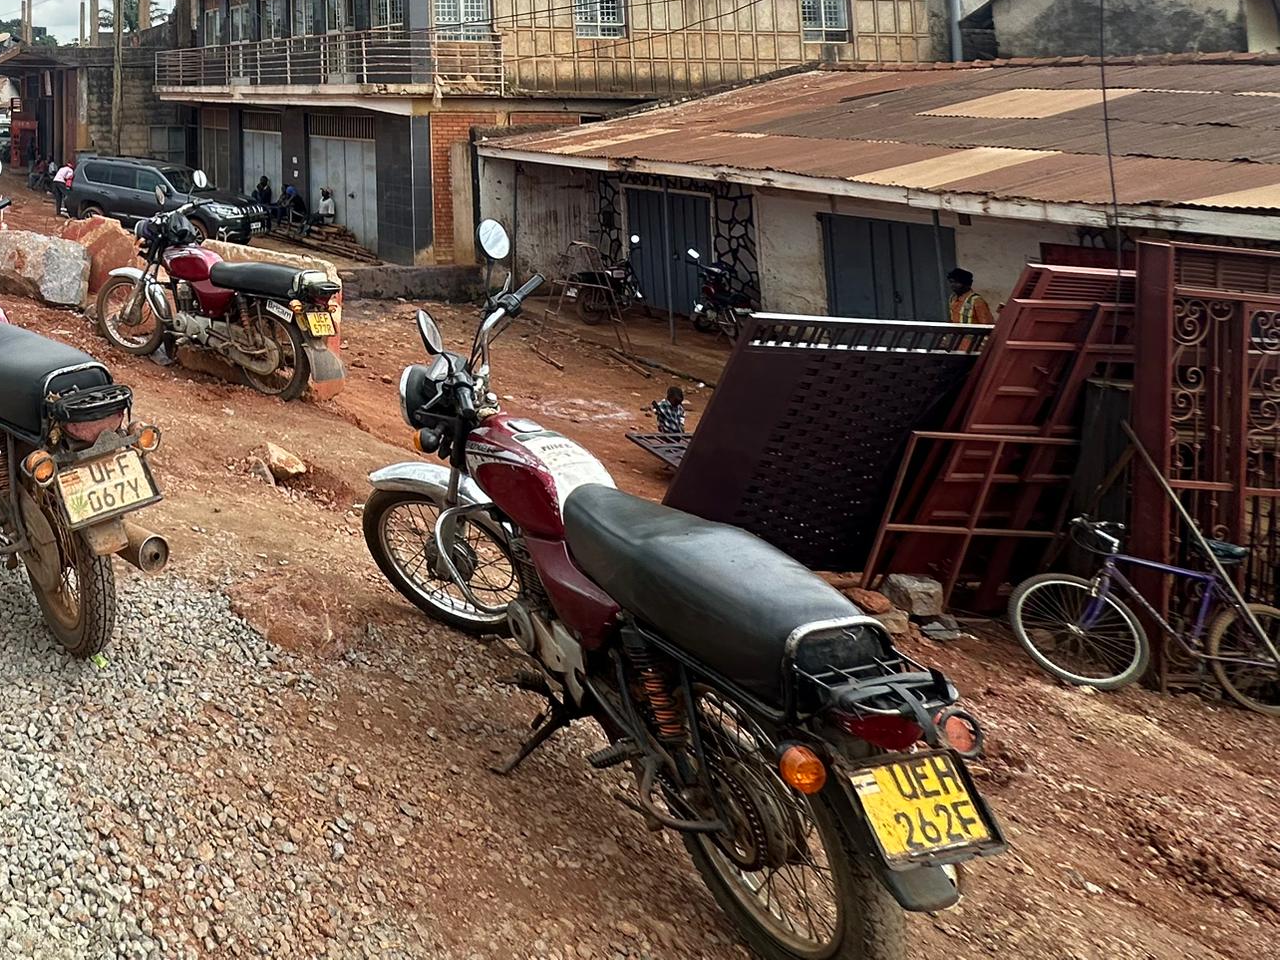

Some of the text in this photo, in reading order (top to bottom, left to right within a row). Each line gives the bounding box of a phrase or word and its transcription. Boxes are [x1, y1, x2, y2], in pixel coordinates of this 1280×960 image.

[88, 455, 129, 483] UFF
[88, 478, 140, 512] 067Y
[894, 801, 976, 849] 262F
